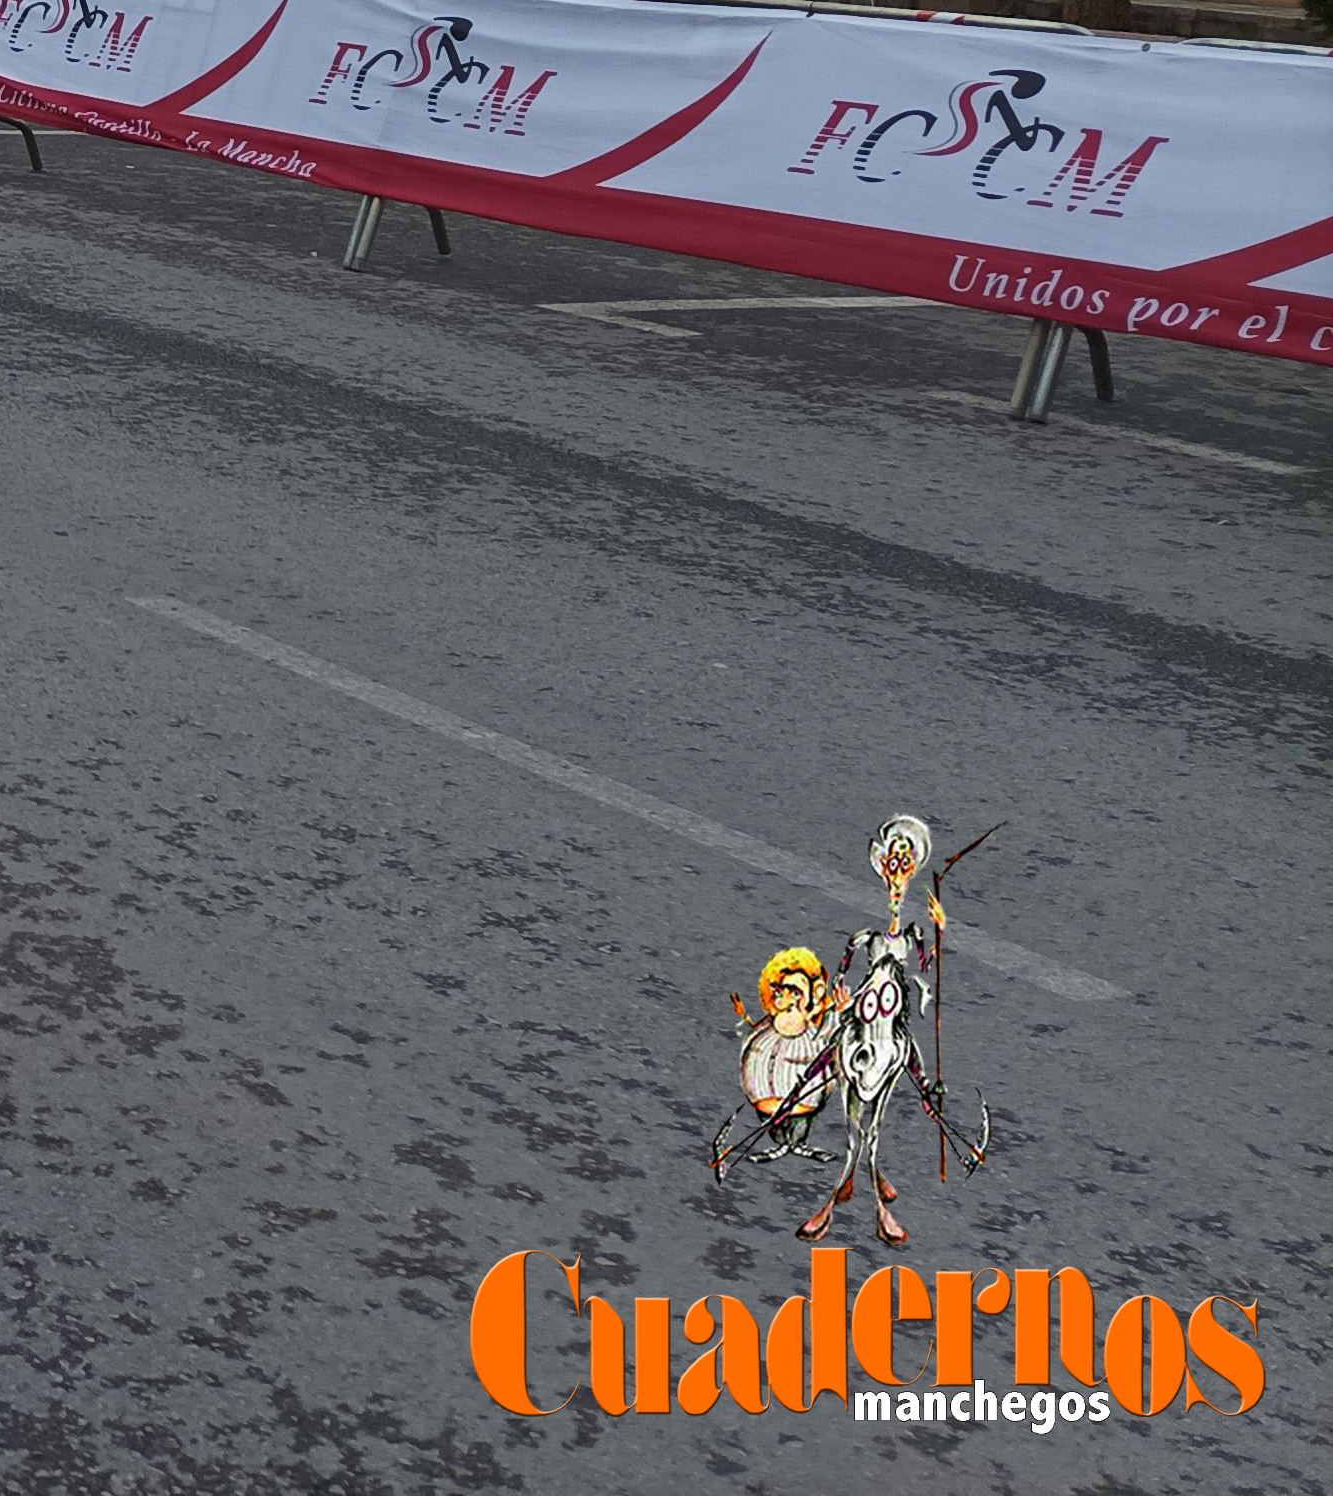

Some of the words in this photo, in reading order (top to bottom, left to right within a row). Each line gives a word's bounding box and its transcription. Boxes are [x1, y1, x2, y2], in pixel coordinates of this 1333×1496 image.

[185, 130, 212, 153] La
[217, 137, 319, 178] Mancha
[947, 254, 1112, 316] Unidos
[1126, 295, 1221, 332] por
[1236, 303, 1292, 344] el
